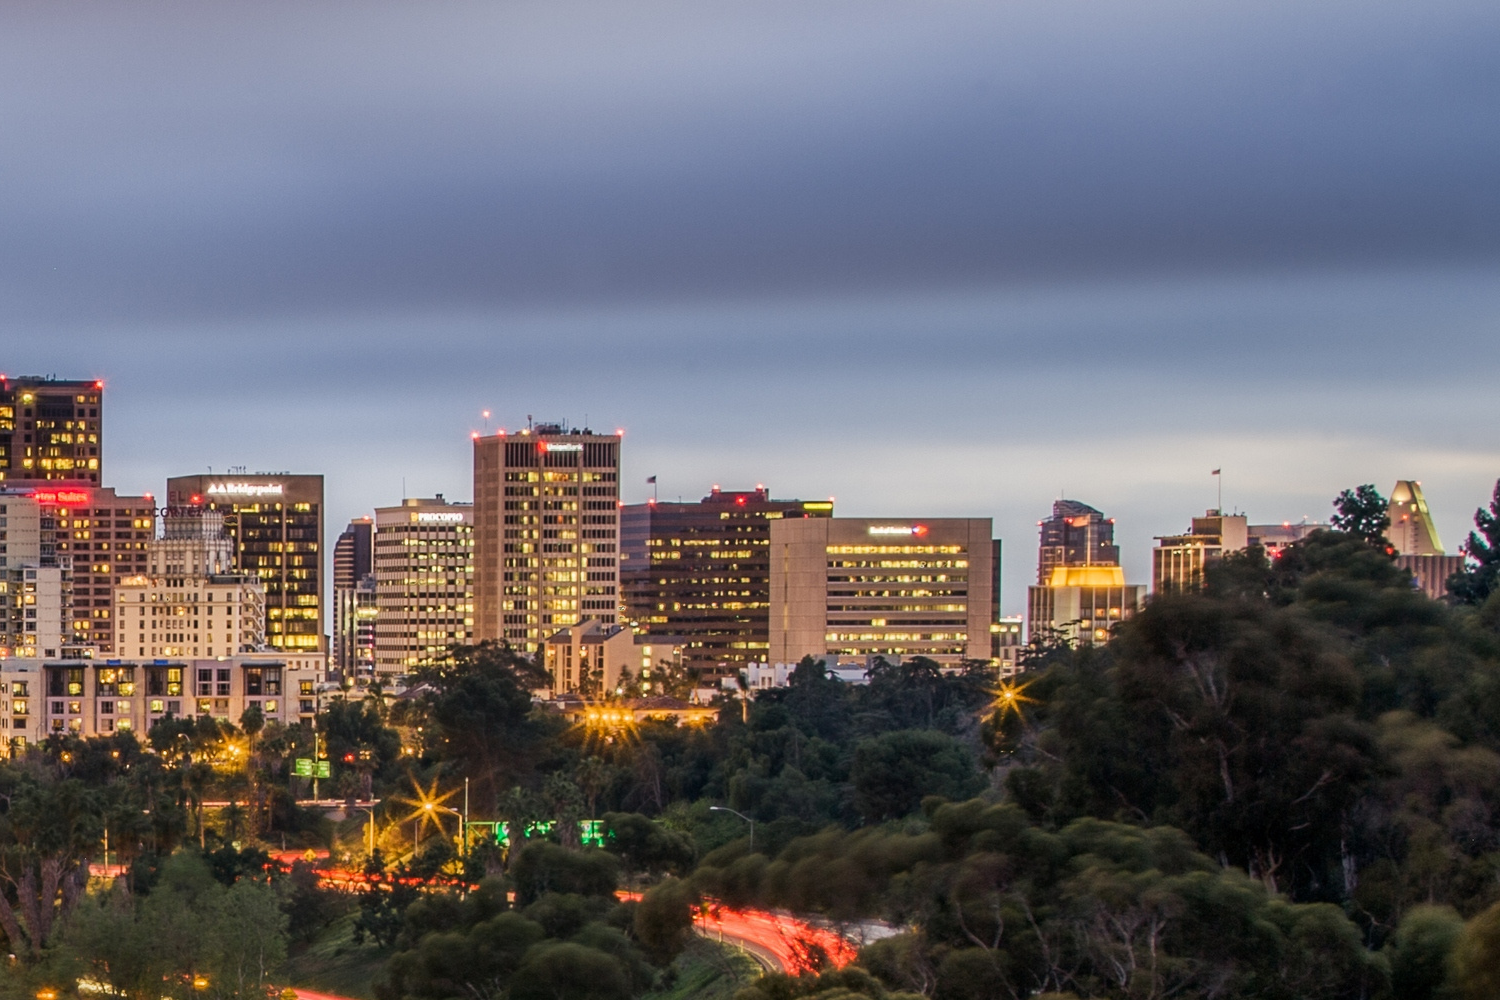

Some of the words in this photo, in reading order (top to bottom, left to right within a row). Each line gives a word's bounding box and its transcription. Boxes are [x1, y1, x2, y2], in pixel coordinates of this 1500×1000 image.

[226, 482, 283, 496] Bridgepoint
[57, 491, 88, 502] Suites
[418, 512, 464, 522] PROCOPIO
